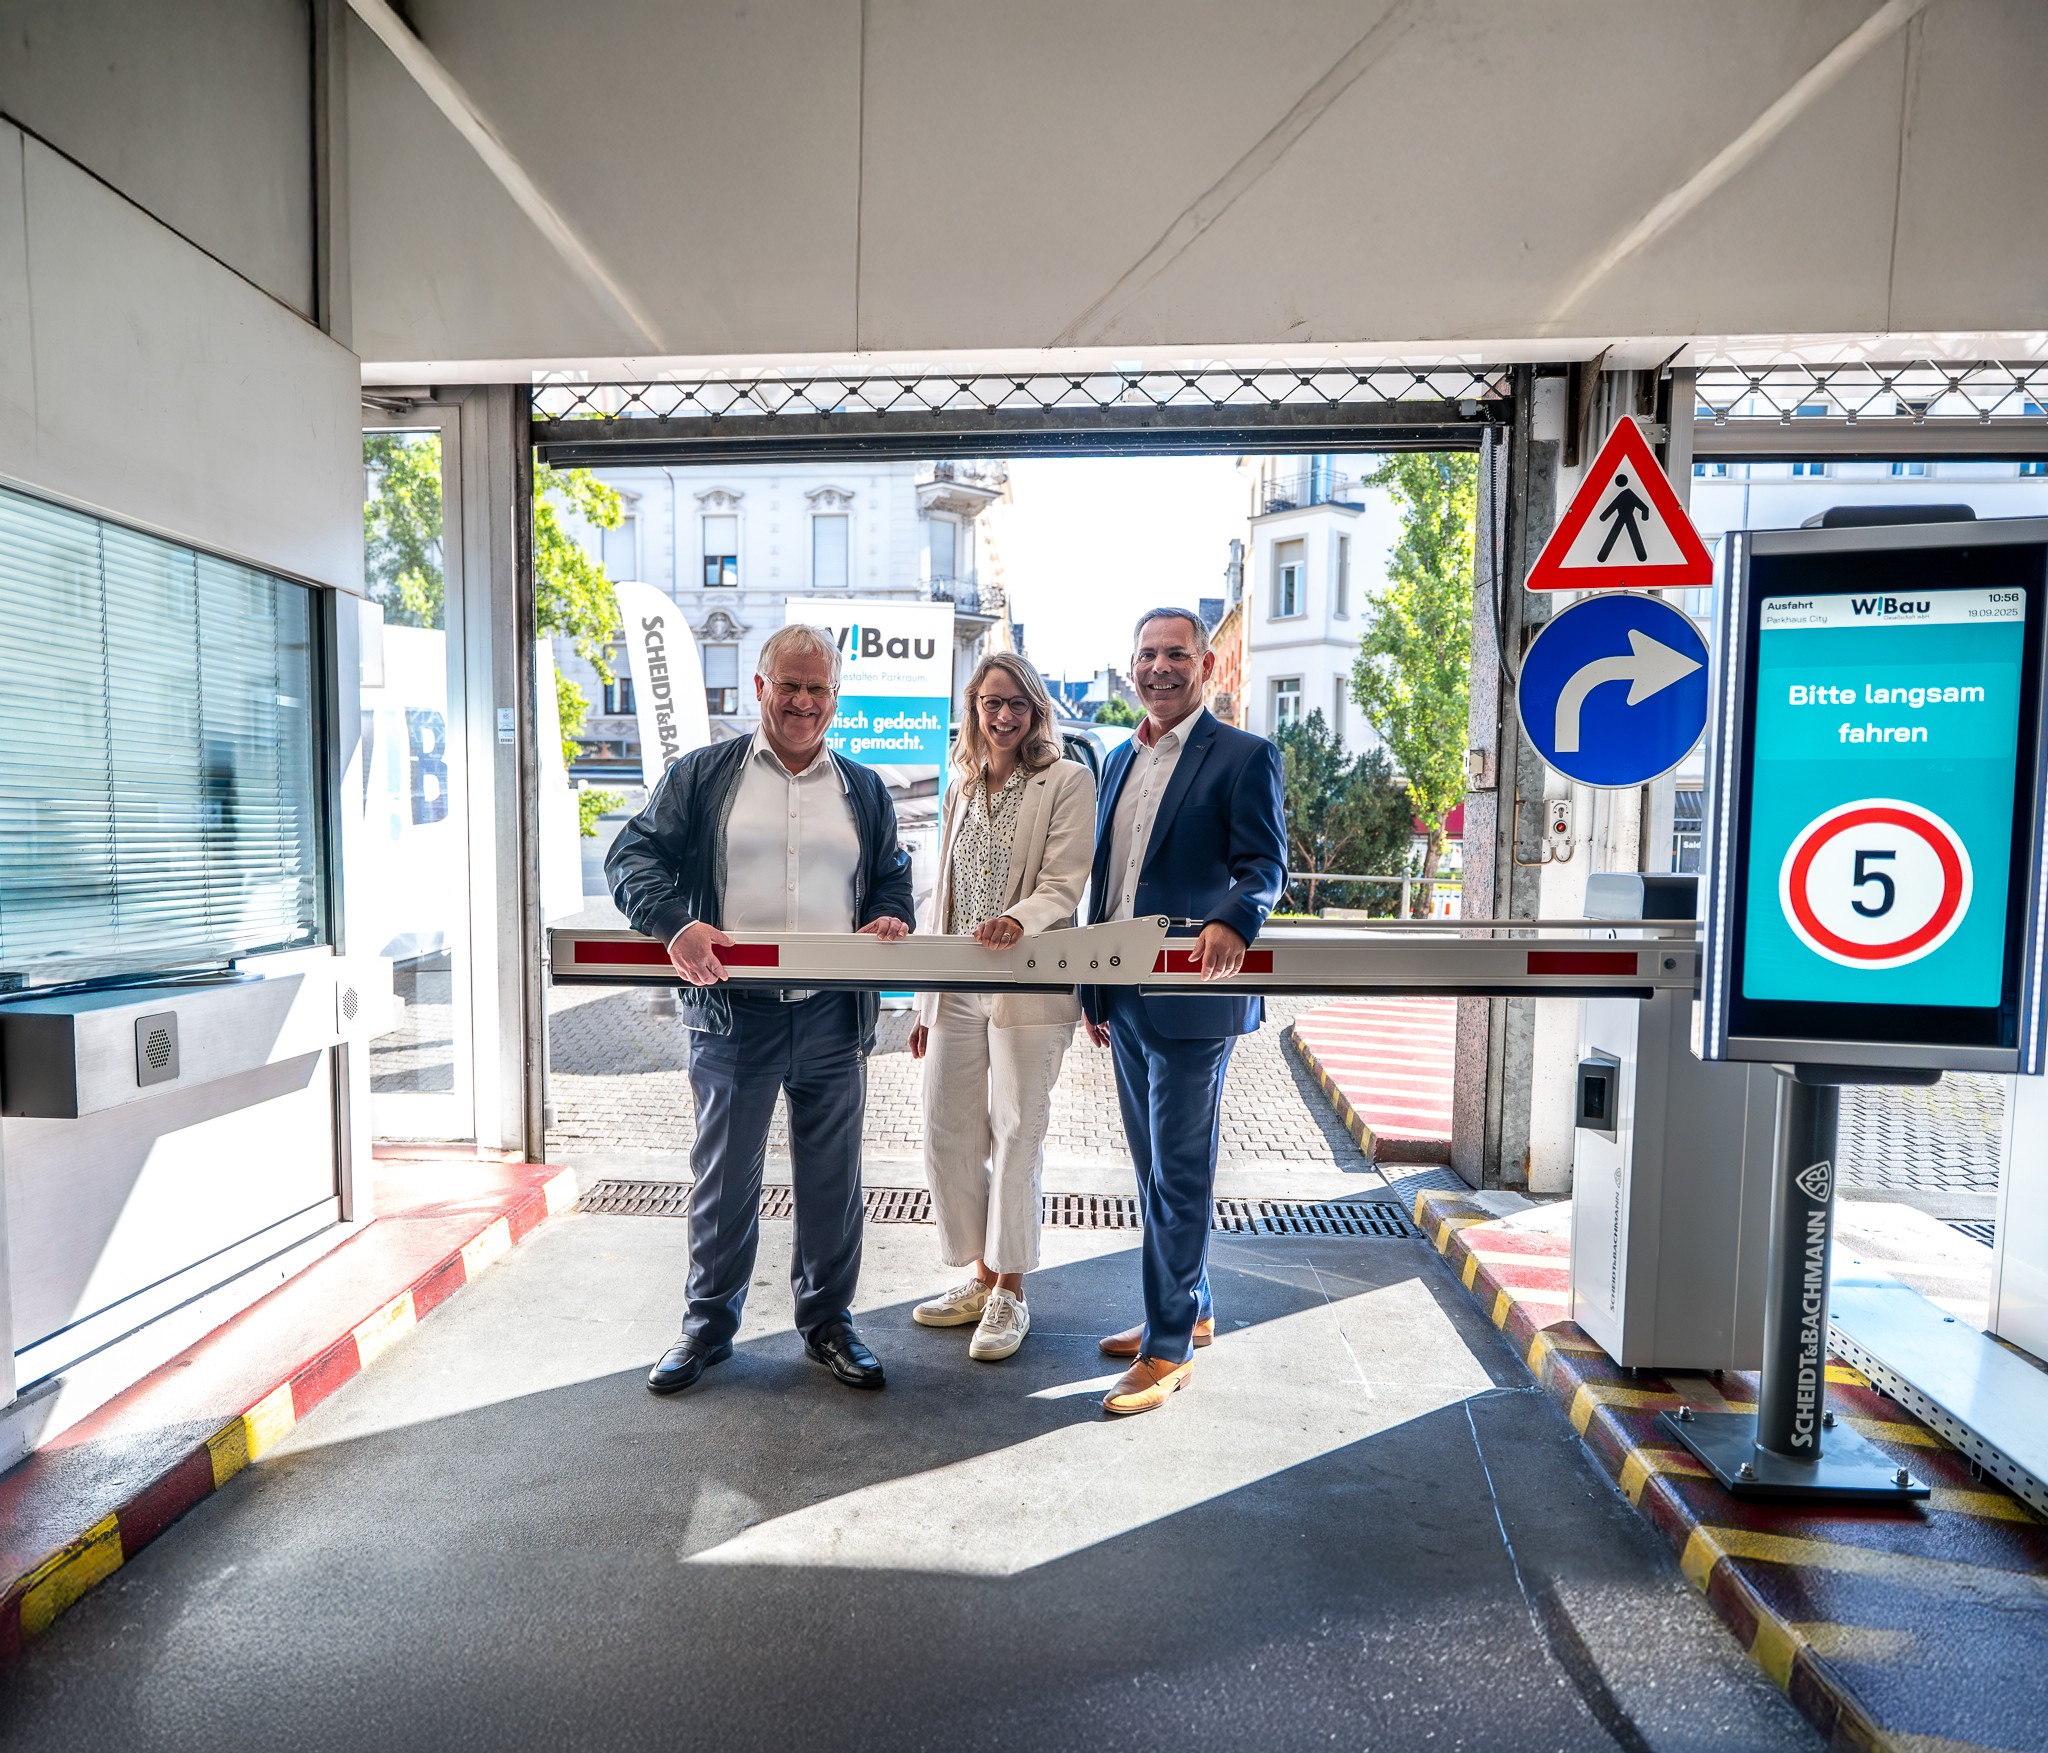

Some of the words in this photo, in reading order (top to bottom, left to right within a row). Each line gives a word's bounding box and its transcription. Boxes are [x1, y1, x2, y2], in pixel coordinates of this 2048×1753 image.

[1767, 601, 1813, 611] Ausfahrt
[1988, 593, 2019, 603] 10:56
[1766, 615, 1807, 624] Parkhaus
[1810, 614, 1828, 624] City
[1968, 608, 2018, 617] 19.09.2025
[1788, 684, 1857, 706] Bitte
[1865, 683, 1985, 709] langsam
[873, 711, 942, 734] gedacht.
[1838, 722, 1928, 744] fahren
[850, 731, 924, 754] gemacht.
[1850, 849, 1896, 919] 5
[1791, 1210, 1827, 1448] SCHEIDT&BACHMANN
